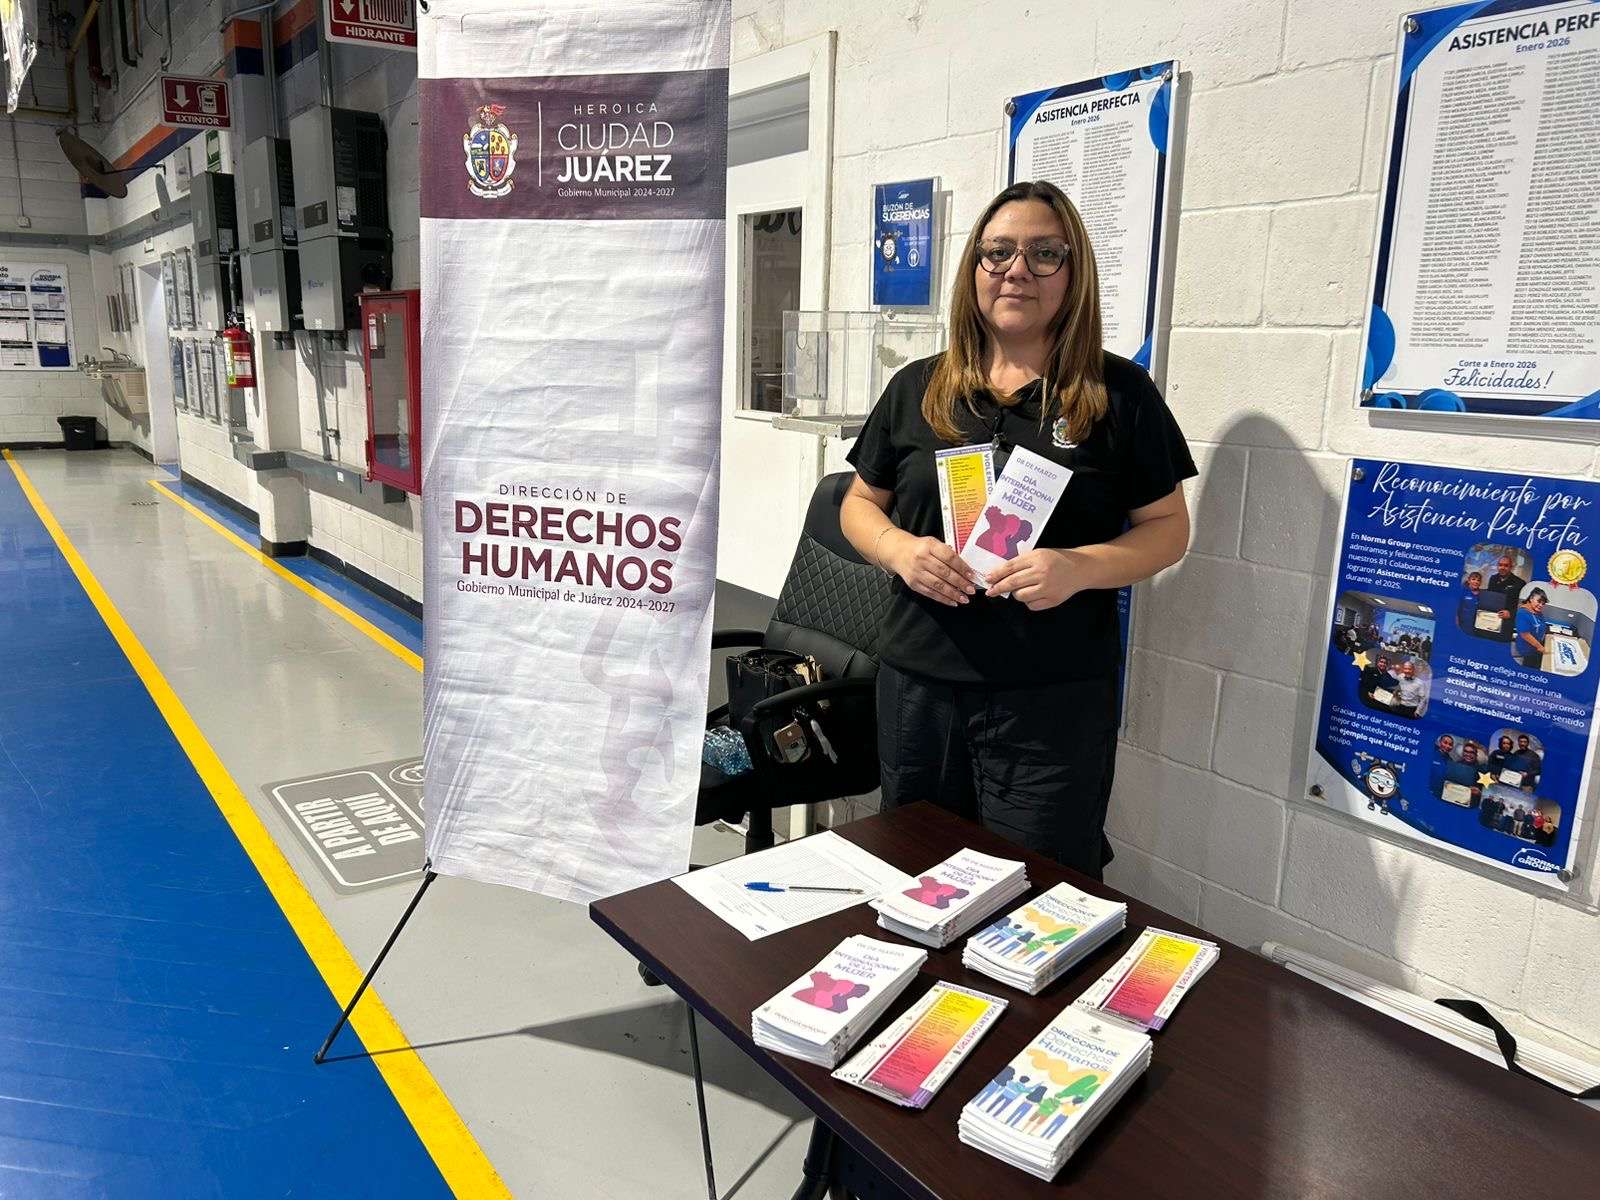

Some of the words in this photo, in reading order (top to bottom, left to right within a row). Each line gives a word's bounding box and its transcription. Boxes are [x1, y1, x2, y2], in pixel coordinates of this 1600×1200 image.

[345, 26, 405, 43] HIDRANTE
[1448, 21, 1549, 52] ASISTENCIA
[1516, 42, 1544, 53] Enero
[1546, 36, 1570, 48] 2026
[176, 114, 220, 126] EXTINTOR
[574, 102, 658, 115] HEROICA
[1035, 102, 1089, 125] ASISTENCIA
[1090, 92, 1141, 114] PERFECTA
[1071, 117, 1086, 126] Enero
[1087, 114, 1101, 124] 2026
[558, 122, 674, 151] CIUDAD
[557, 148, 673, 183] JUÁREZ
[558, 187, 592, 197] Gobierno
[595, 187, 631, 198] Municipal
[634, 187, 675, 197] 2024-2027
[882, 209, 930, 222] SUGERENCIAS
[904, 202, 914, 211] DE
[1459, 359, 1482, 368] Corte
[1490, 359, 1515, 369] Enero
[1516, 360, 1537, 369] 2026
[1024, 460, 1034, 470] DE
[1033, 464, 1058, 480] MARZO
[499, 484, 596, 502] DIRECCIÓN
[606, 491, 627, 504] DE
[1001, 492, 1037, 514] MUJER
[1012, 488, 1023, 498] DE
[1023, 491, 1034, 502] LA
[1372, 462, 1540, 515] Reconocimiento
[1542, 492, 1592, 521] por
[455, 499, 682, 552] DERECHOS
[1367, 490, 1483, 533] Asistencia
[1486, 505, 1588, 552] Perfecta
[1351, 532, 1360, 540] En
[1361, 533, 1386, 545] Norma
[1387, 537, 1411, 549] Group
[1349, 543, 1388, 555] admiramos
[1388, 549, 1394, 557] y
[1394, 548, 1434, 563] felicitamos
[462, 541, 674, 595] HUMANOS
[1346, 563, 1376, 576] lograron
[1376, 567, 1415, 581] Asistencia
[1416, 573, 1450, 588] Perfecta
[1348, 553, 1377, 565] nuestros
[1378, 557, 1388, 565] 81
[1389, 559, 1441, 575] Colaboradores
[1442, 570, 1459, 579] que
[1345, 572, 1373, 584] durante
[1374, 578, 1382, 587] el
[456, 579, 505, 596] Gobierno
[508, 584, 560, 602] Municipal
[563, 589, 576, 602] de
[578, 591, 613, 607] Juárez
[616, 596, 675, 613] 2024-2027
[1447, 665, 1489, 682] disciplina,
[1490, 675, 1508, 685] sino
[1543, 689, 1562, 699] una
[1450, 655, 1466, 665] Este
[1467, 658, 1489, 671] logro
[1490, 663, 1516, 678] refleja
[1517, 671, 1528, 680] no
[1529, 674, 1549, 685] solo
[1444, 687, 1459, 696] con
[1460, 689, 1468, 698] la
[1468, 694, 1504, 708] empresa
[1504, 702, 1520, 711] con
[1521, 705, 1533, 714] un
[1534, 707, 1551, 719] alto
[1552, 712, 1585, 728] sentido
[1446, 676, 1475, 690] actitud
[1476, 683, 1511, 699] positiva
[1511, 693, 1518, 701] y
[1518, 695, 1530, 704] un
[1531, 698, 1586, 717] compromiso
[1332, 705, 1356, 718] Gracias
[1357, 713, 1370, 723] por
[1370, 713, 1383, 724] dar
[1383, 717, 1413, 734] siempre
[1413, 726, 1421, 735] lo
[1443, 696, 1454, 706] de
[1454, 700, 1524, 725] responsabilidad.
[1329, 725, 1339, 733] un
[1339, 727, 1367, 743] ejemplo
[1368, 735, 1383, 746] que
[1383, 737, 1410, 754] inspira
[1410, 746, 1418, 756] al
[1331, 715, 1350, 728] mejor
[1350, 720, 1361, 729] de
[1361, 723, 1387, 737] ustedes
[1387, 731, 1393, 739] y
[1394, 733, 1407, 743] por
[1408, 736, 1420, 746] ser
[295, 797, 366, 849] PARTIR
[371, 822, 421, 846] DE
[332, 843, 377, 860] A
[1526, 854, 1561, 871] NORMA
[1517, 857, 1552, 872] GROUP
